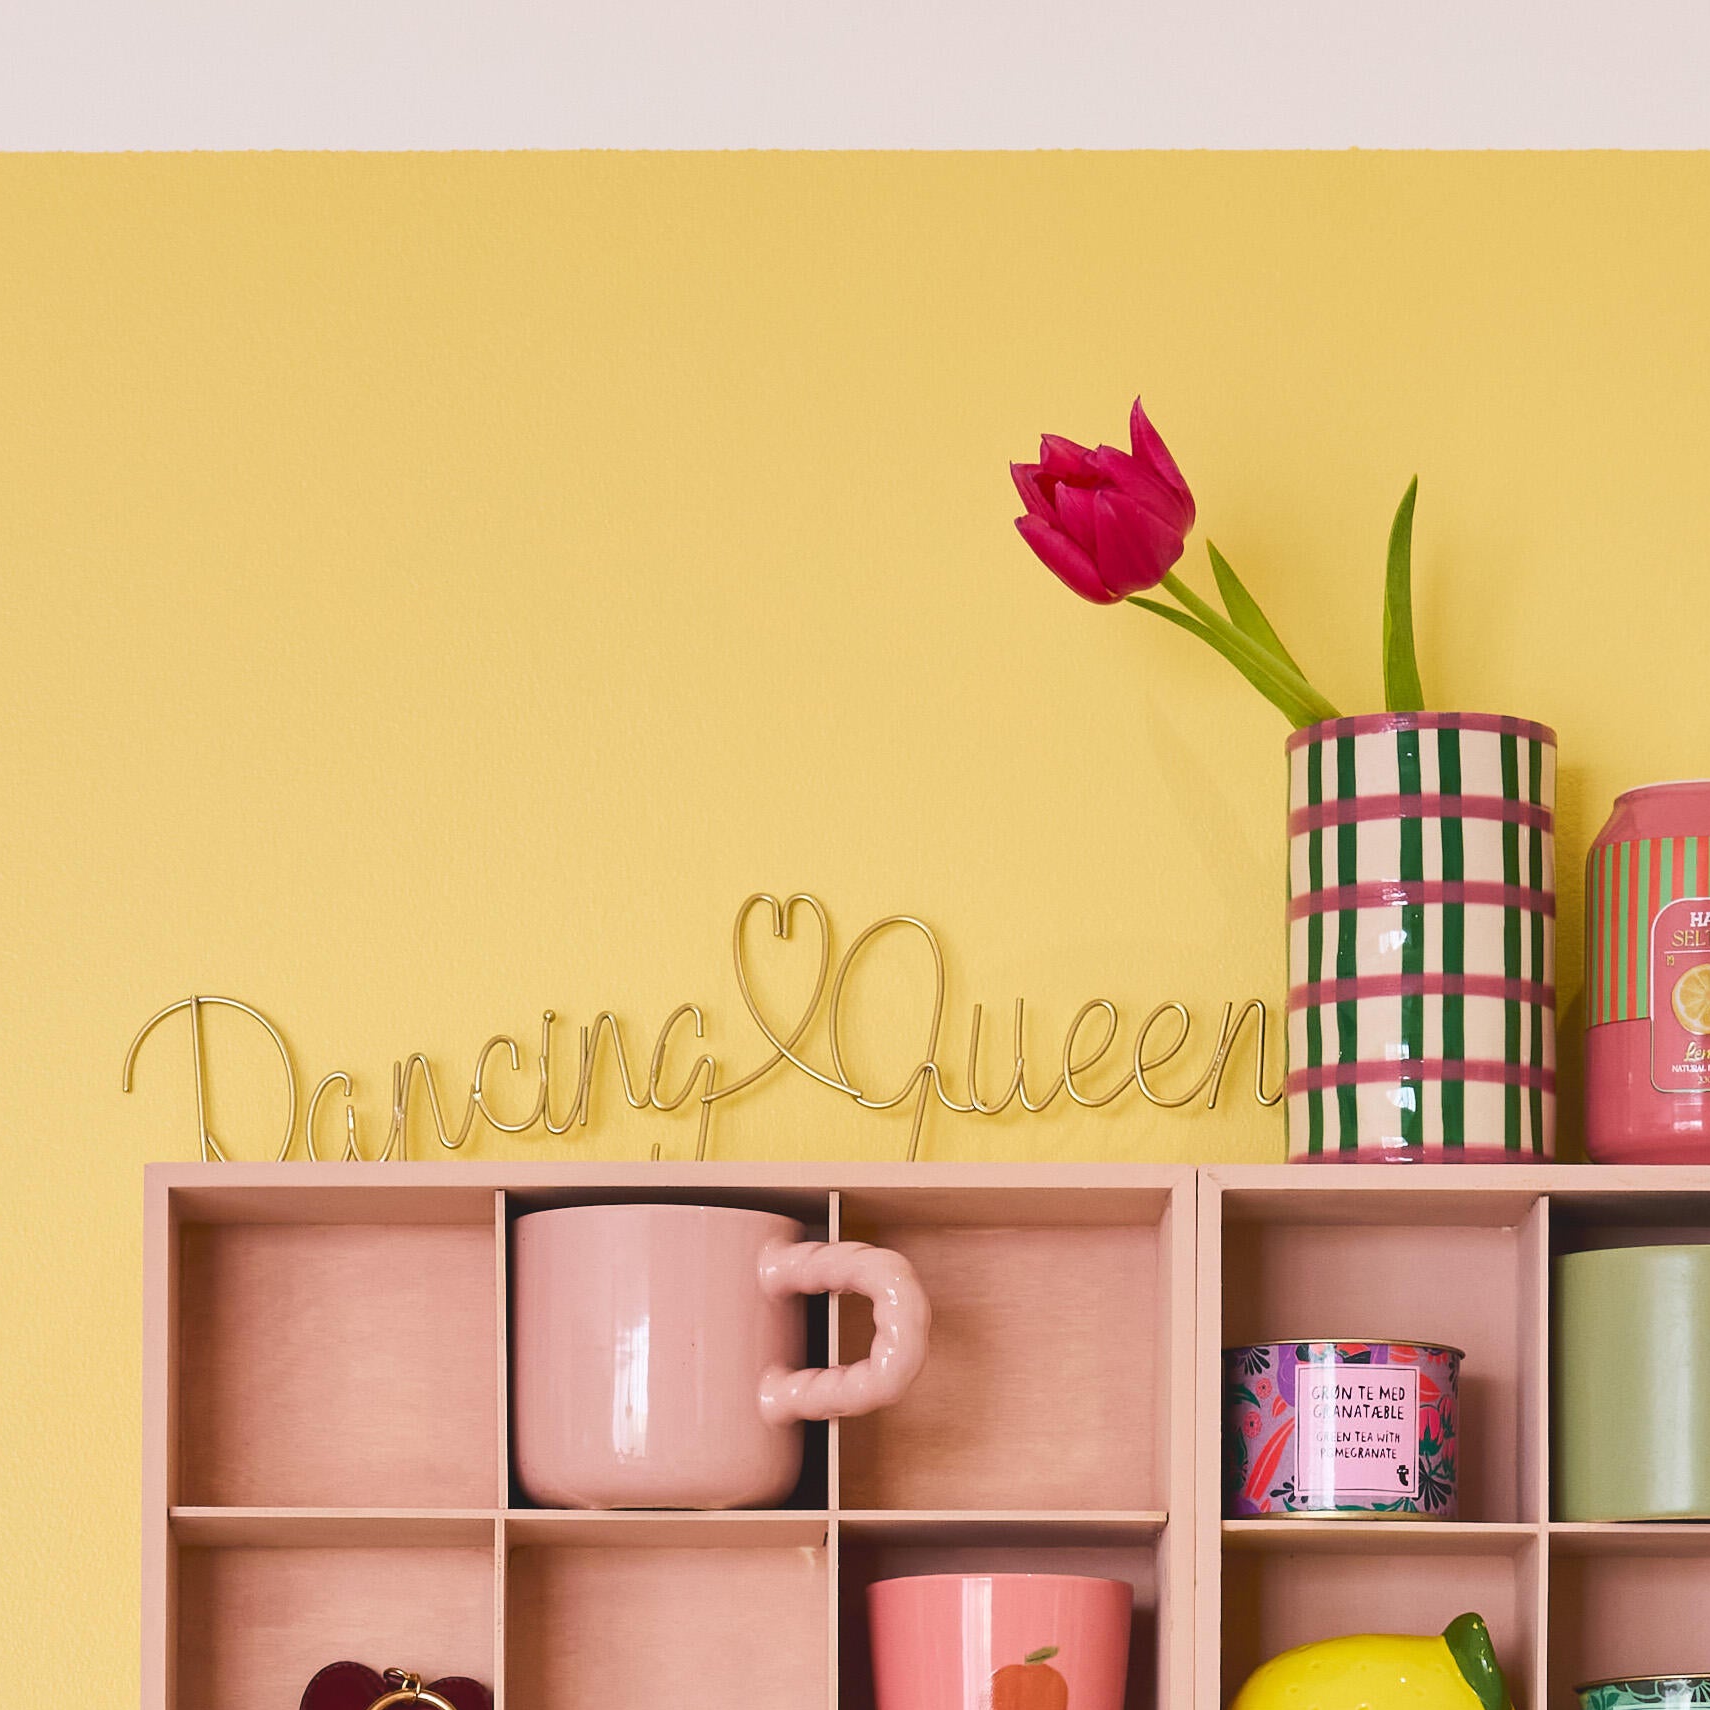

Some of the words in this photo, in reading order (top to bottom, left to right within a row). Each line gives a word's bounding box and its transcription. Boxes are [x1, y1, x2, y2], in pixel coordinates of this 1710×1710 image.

[123, 991, 720, 1162] Dancing
[830, 913, 1286, 1162] Queen
[1671, 1064, 1706, 1073] NATURAL
[1358, 1385, 1374, 1401] TE
[1379, 1385, 1406, 1402] MED
[1316, 1430, 1352, 1443] GREN
[1355, 1431, 1373, 1443] TEA
